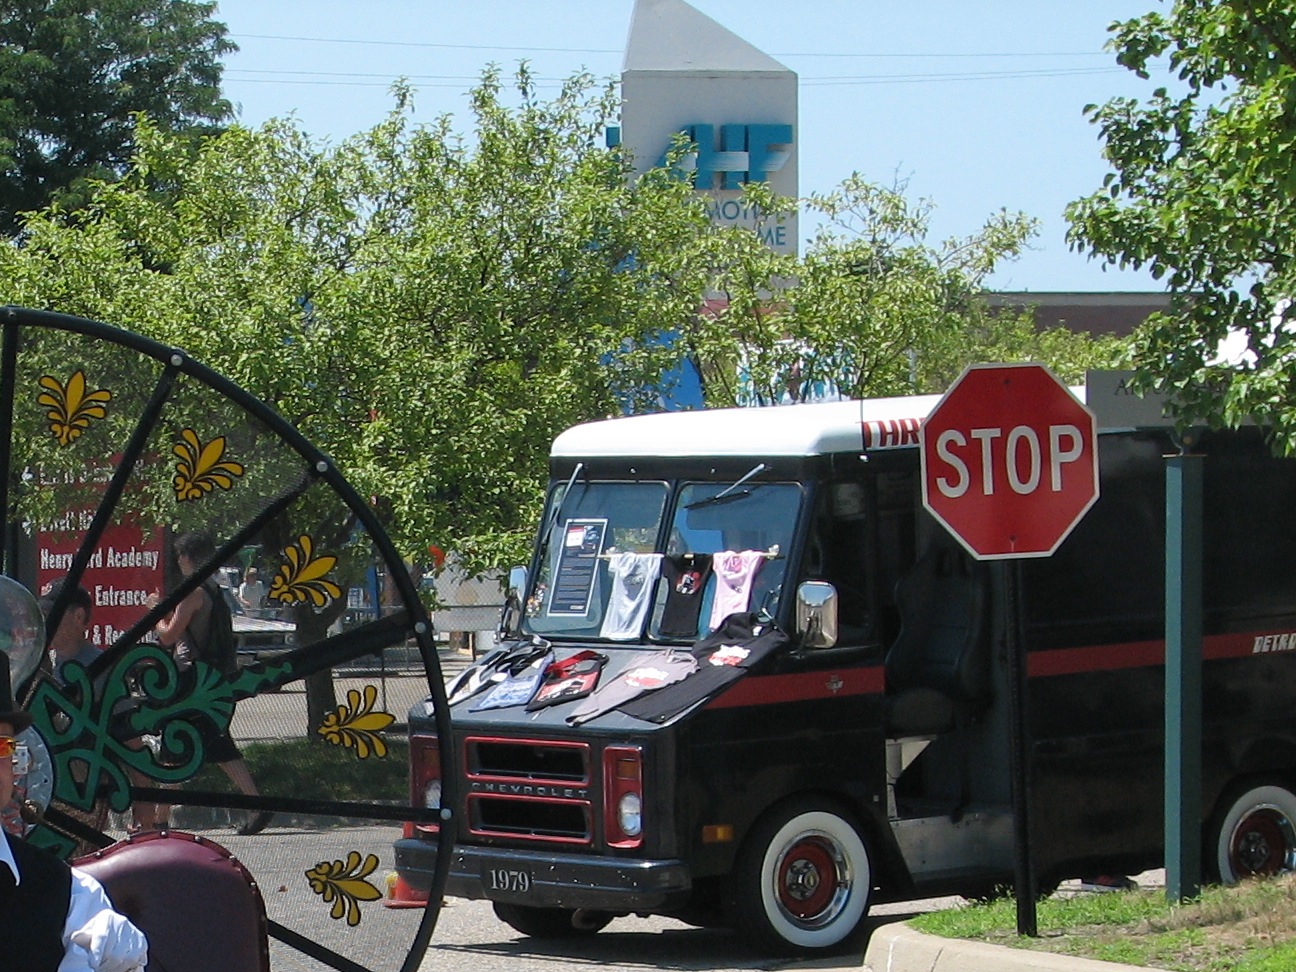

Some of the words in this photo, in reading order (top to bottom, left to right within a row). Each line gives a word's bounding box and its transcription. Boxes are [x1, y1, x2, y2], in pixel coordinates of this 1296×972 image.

[856, 417, 925, 448] THR
[936, 424, 1084, 498] STOP
[40, 548, 73, 571] Henry
[76, 547, 103, 569] rd
[106, 546, 159, 570] Academy
[95, 585, 148, 606] Entrance
[92, 624, 102, 645] &
[472, 782, 588, 798] CHEVROLET
[490, 869, 530, 893] 1979
